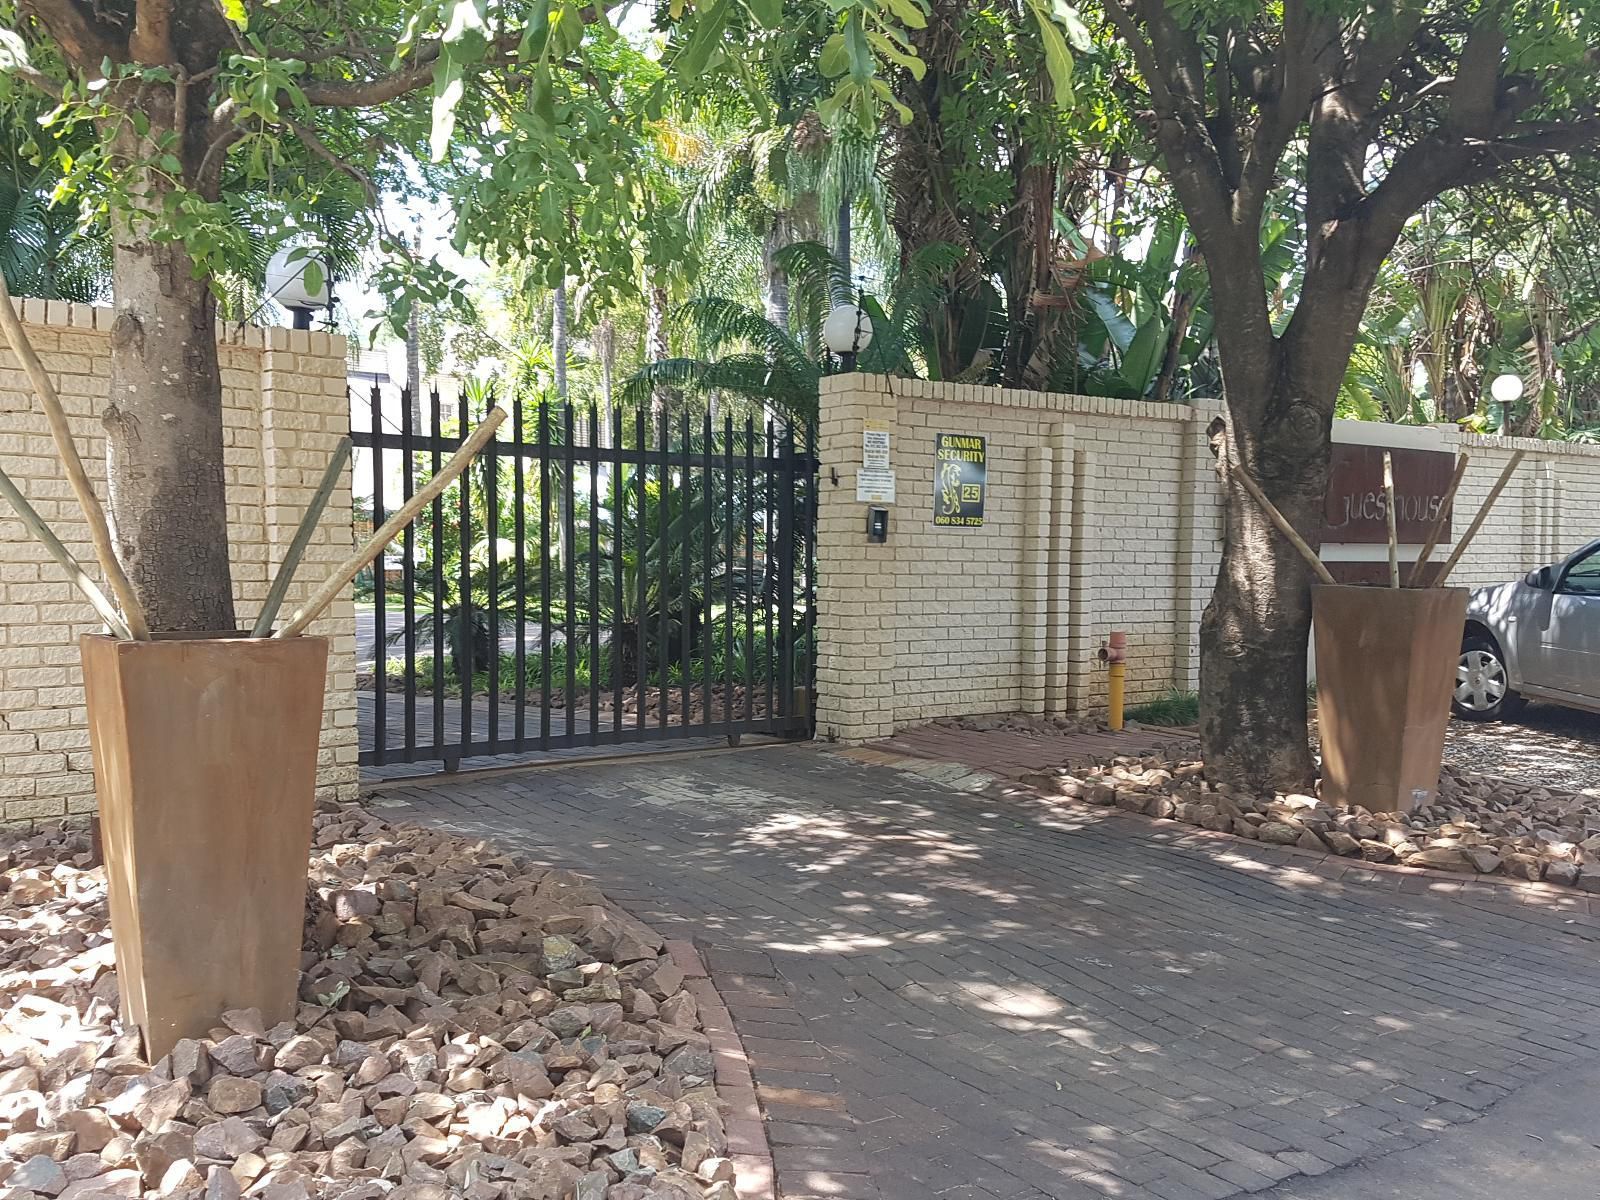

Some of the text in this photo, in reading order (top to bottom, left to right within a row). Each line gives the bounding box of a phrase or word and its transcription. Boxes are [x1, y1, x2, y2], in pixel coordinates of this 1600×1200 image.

[941, 436, 981, 449] GUNMAR
[937, 449, 985, 462] SECURITY
[964, 487, 978, 498] 25
[951, 517, 964, 525] 834
